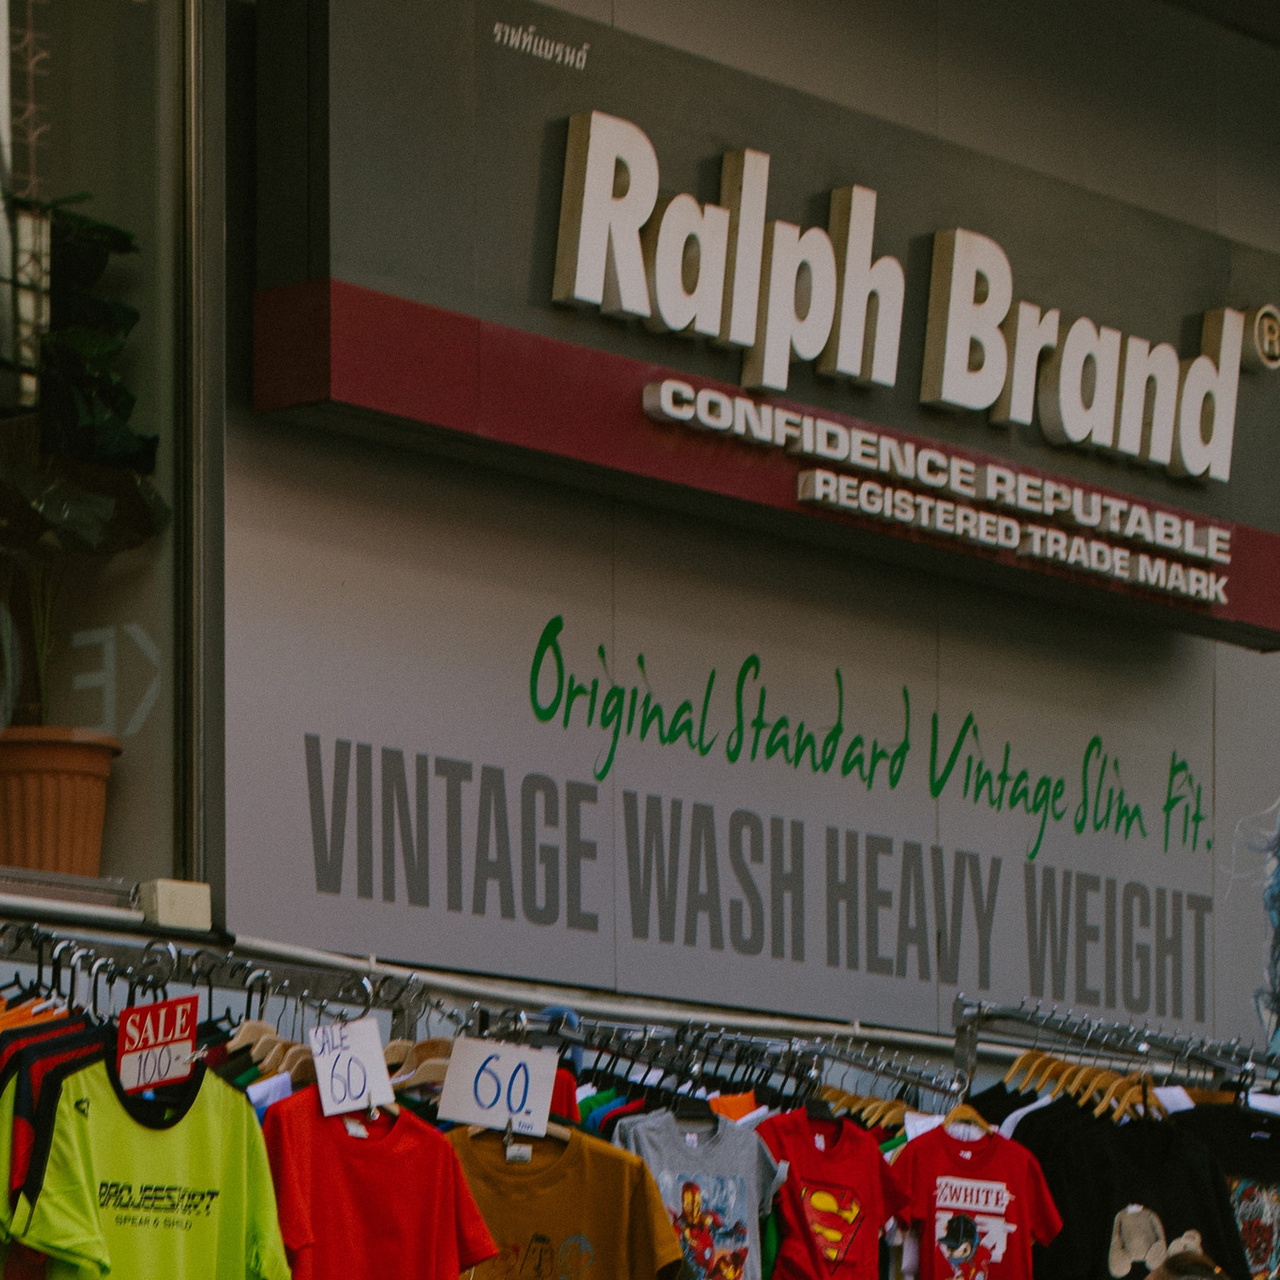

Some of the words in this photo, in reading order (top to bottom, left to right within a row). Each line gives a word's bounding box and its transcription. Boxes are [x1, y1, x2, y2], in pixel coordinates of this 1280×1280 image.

[565, 110, 906, 391] Ralph
[930, 228, 1244, 482] Brand
[658, 378, 977, 498] CONFIDENCE
[986, 462, 1233, 564] REPUTABLE
[814, 469, 1021, 550] REGISTERED
[1027, 524, 1131, 579] TRADE
[1137, 553, 1230, 604] MARK
[529, 615, 717, 781] Original
[726, 655, 910, 791] Standard
[929, 712, 1067, 861] Vintage
[1073, 733, 1148, 838] Slim
[304, 734, 599, 932] VINTAGE
[622, 790, 806, 964] WASH
[824, 826, 1002, 992] HEAVY
[1023, 858, 1214, 1024] WEIGHT
[124, 1002, 193, 1052] SALE
[312, 1024, 350, 1058] SALE
[330, 1052, 368, 1105] 60
